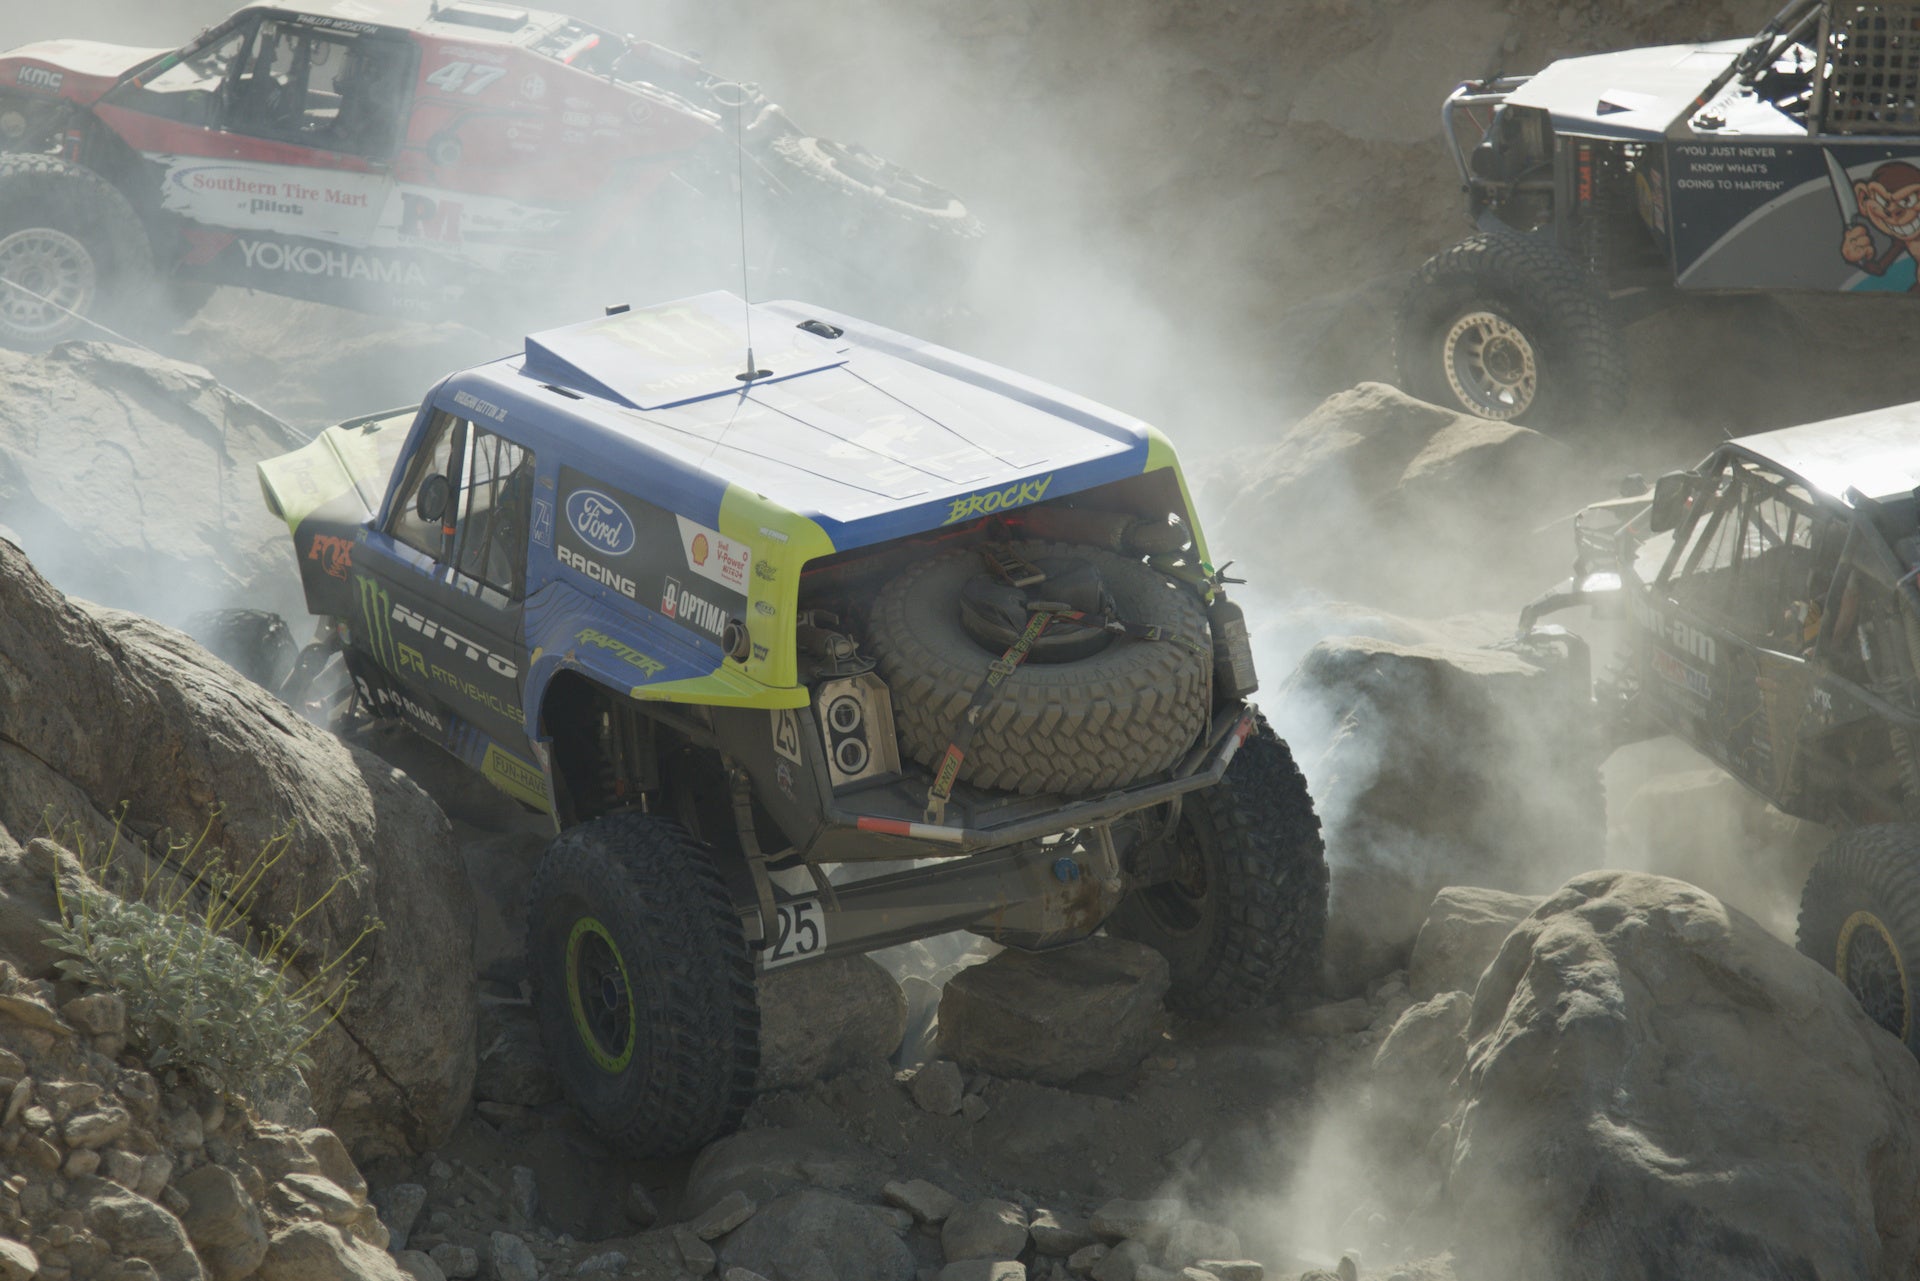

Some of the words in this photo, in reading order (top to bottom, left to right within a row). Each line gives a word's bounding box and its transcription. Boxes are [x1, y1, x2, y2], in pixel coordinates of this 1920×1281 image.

[18, 65, 63, 88] KMC
[426, 61, 507, 96] 47
[1690, 163, 1724, 173] KNOW
[1726, 163, 1768, 174] WHAT'S
[1710, 146, 1736, 157] JUST
[1739, 146, 1776, 158] NEVER
[193, 173, 277, 196] Southern
[282, 183, 320, 201] Tire
[325, 188, 369, 207] Mart
[1678, 179, 1715, 189] GOING
[1717, 180, 1733, 189] TO
[238, 239, 427, 287] YOKOHAMA
[577, 497, 622, 549] Ford
[944, 474, 1053, 526] BROCKY
[308, 533, 354, 580] FOX
[557, 545, 636, 599] RACING
[716, 550, 745, 570] V-Power
[679, 590, 728, 638] OPTIMA
[391, 603, 520, 679] NITTO
[574, 628, 667, 680] RAPTOR
[431, 665, 459, 691] RTR
[458, 680, 527, 726] VEHICLES
[770, 902, 819, 962] 25
